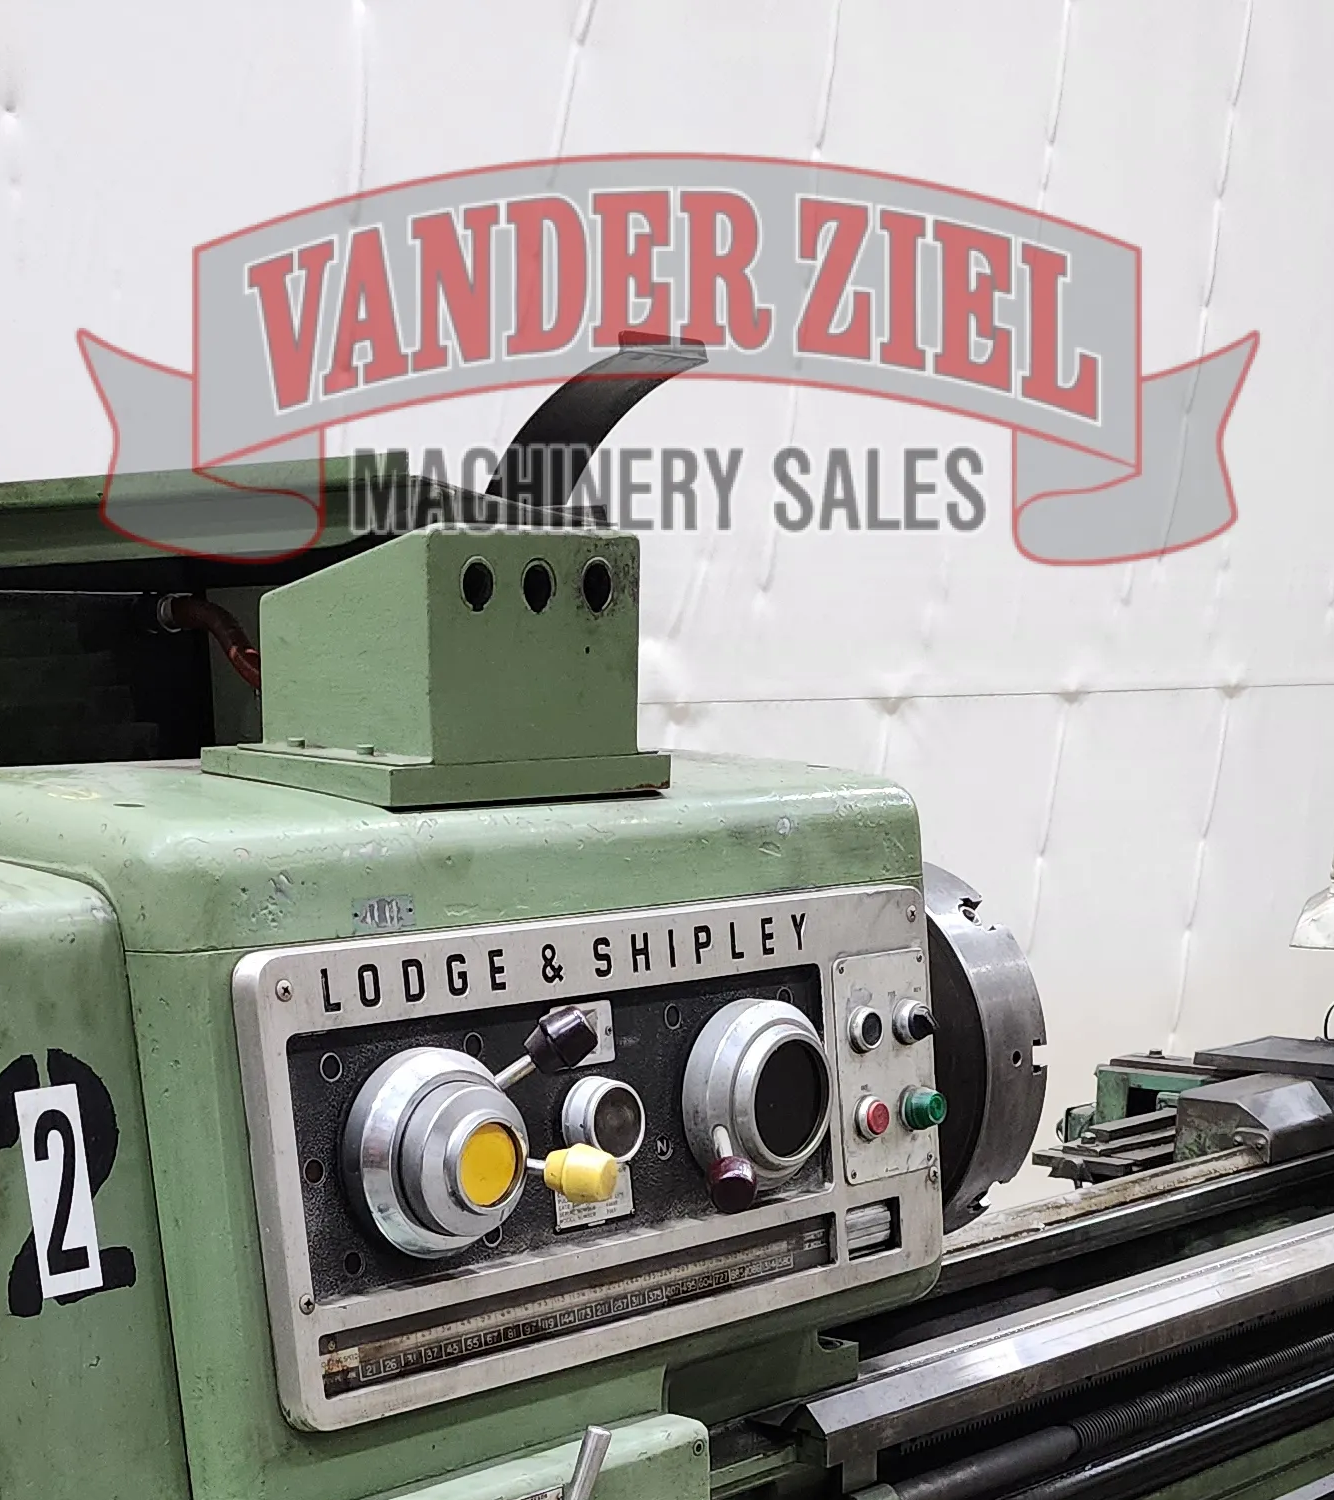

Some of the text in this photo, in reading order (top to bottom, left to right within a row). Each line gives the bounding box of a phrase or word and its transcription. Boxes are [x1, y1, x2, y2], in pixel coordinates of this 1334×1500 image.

[321, 912, 807, 1014] LODGE & SHIPLEY
[34, 1109, 90, 1276] 2
[366, 1364, 377, 1377] 21
[385, 1360, 397, 1371] 26
[427, 1349, 438, 1360] 37
[446, 1344, 459, 1355] 45
[467, 1338, 479, 1349] 55
[507, 1328, 517, 1339] 81
